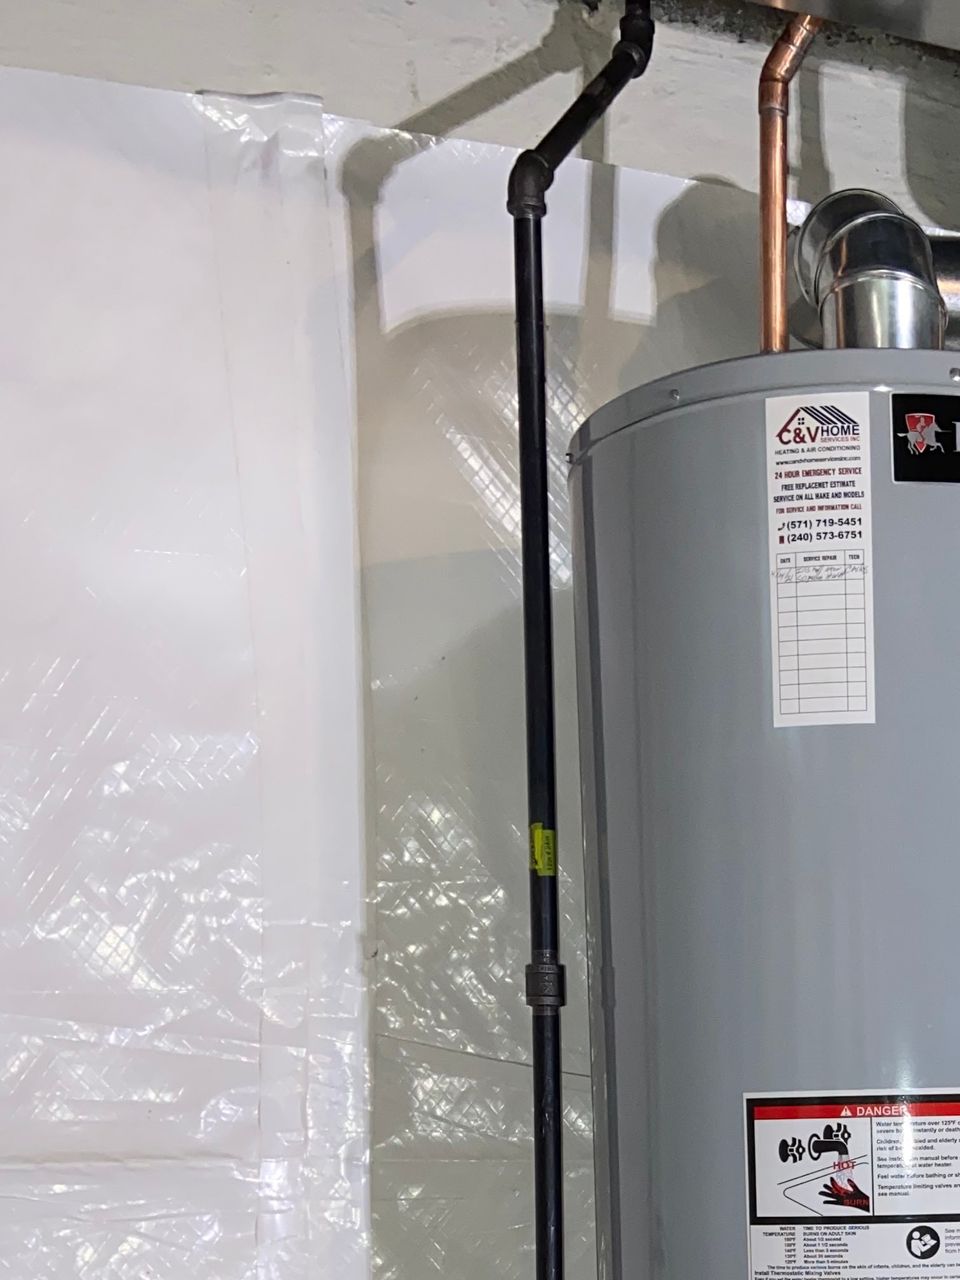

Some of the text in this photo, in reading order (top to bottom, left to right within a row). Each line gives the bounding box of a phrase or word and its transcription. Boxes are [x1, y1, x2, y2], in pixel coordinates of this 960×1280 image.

[780, 424, 860, 445] C&V HOME
[775, 467, 862, 480] 24 HOUR EMERGENCY SERVICE
[781, 483, 794, 492] FREE
[830, 480, 856, 488] ESTIMATE
[773, 495, 795, 503] SERVICE
[805, 493, 814, 501] ALL
[815, 492, 830, 500] MAKE
[786, 506, 805, 514] SERVICE
[787, 518, 862, 531] (571) 719-5451
[787, 530, 862, 543] (240) 573-6751
[856, 1105, 906, 1116] DANGER
[833, 1161, 857, 1171] HOT
